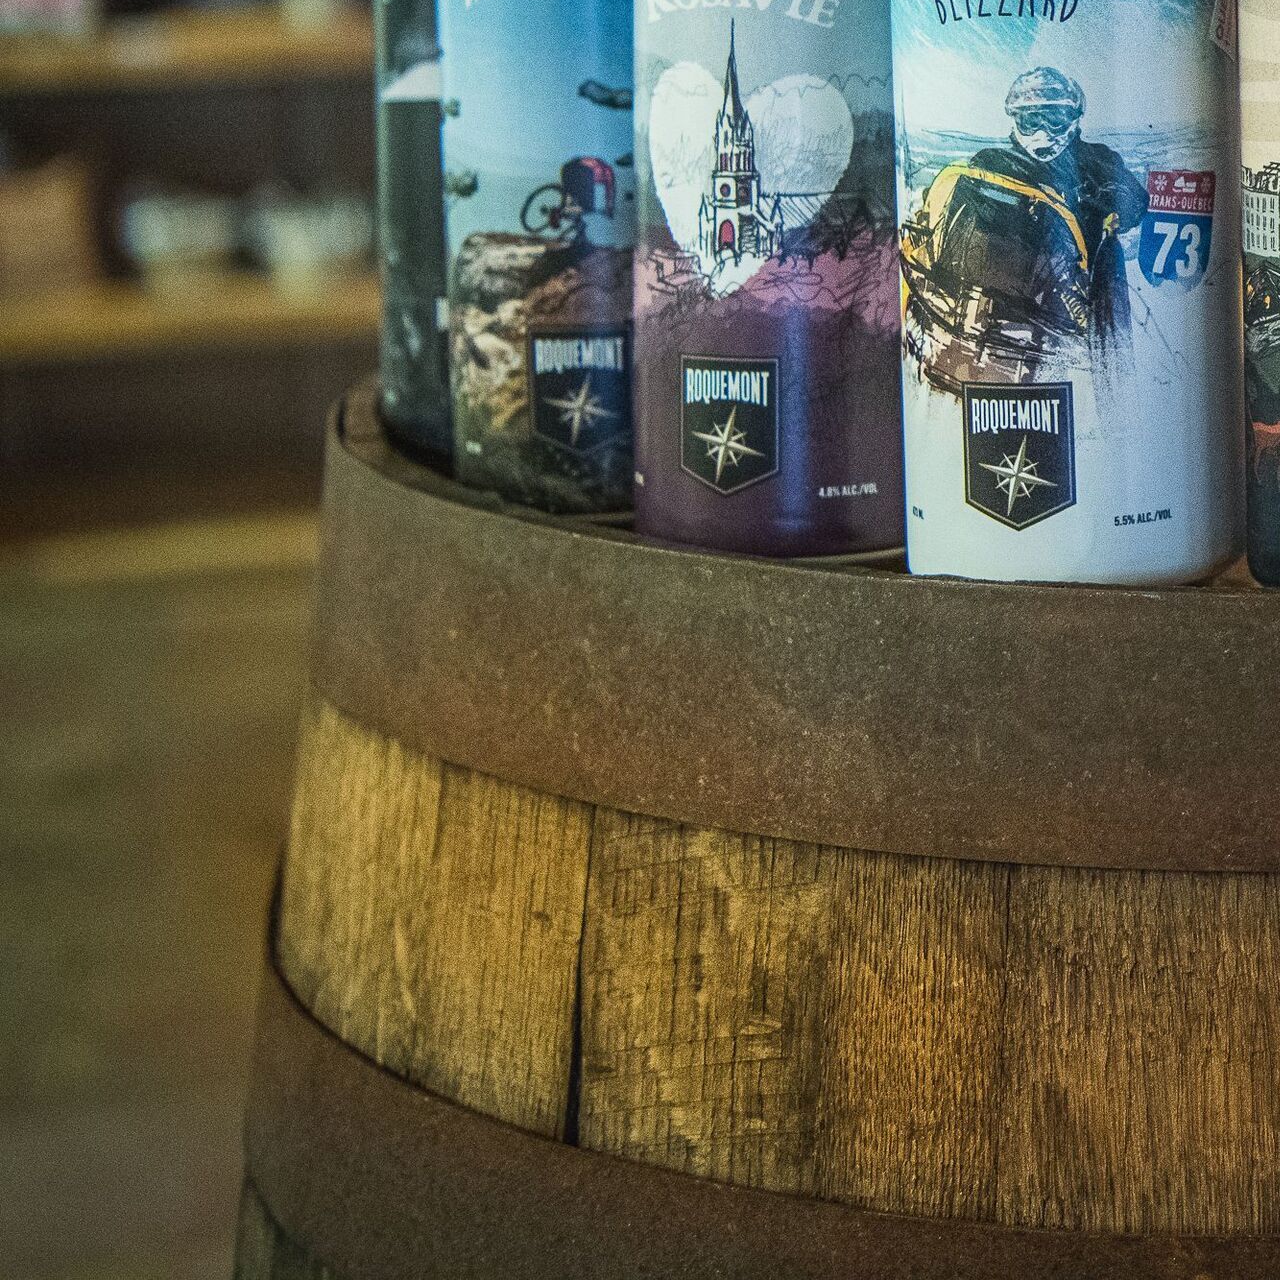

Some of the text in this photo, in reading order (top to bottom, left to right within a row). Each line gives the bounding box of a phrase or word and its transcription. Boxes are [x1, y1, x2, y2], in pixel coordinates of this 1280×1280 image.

[1152, 221, 1201, 278] 73
[686, 367, 771, 408] ROQUEMONT
[970, 398, 1060, 435] ROQUEMONT
[1114, 514, 1136, 527] 5.5%
